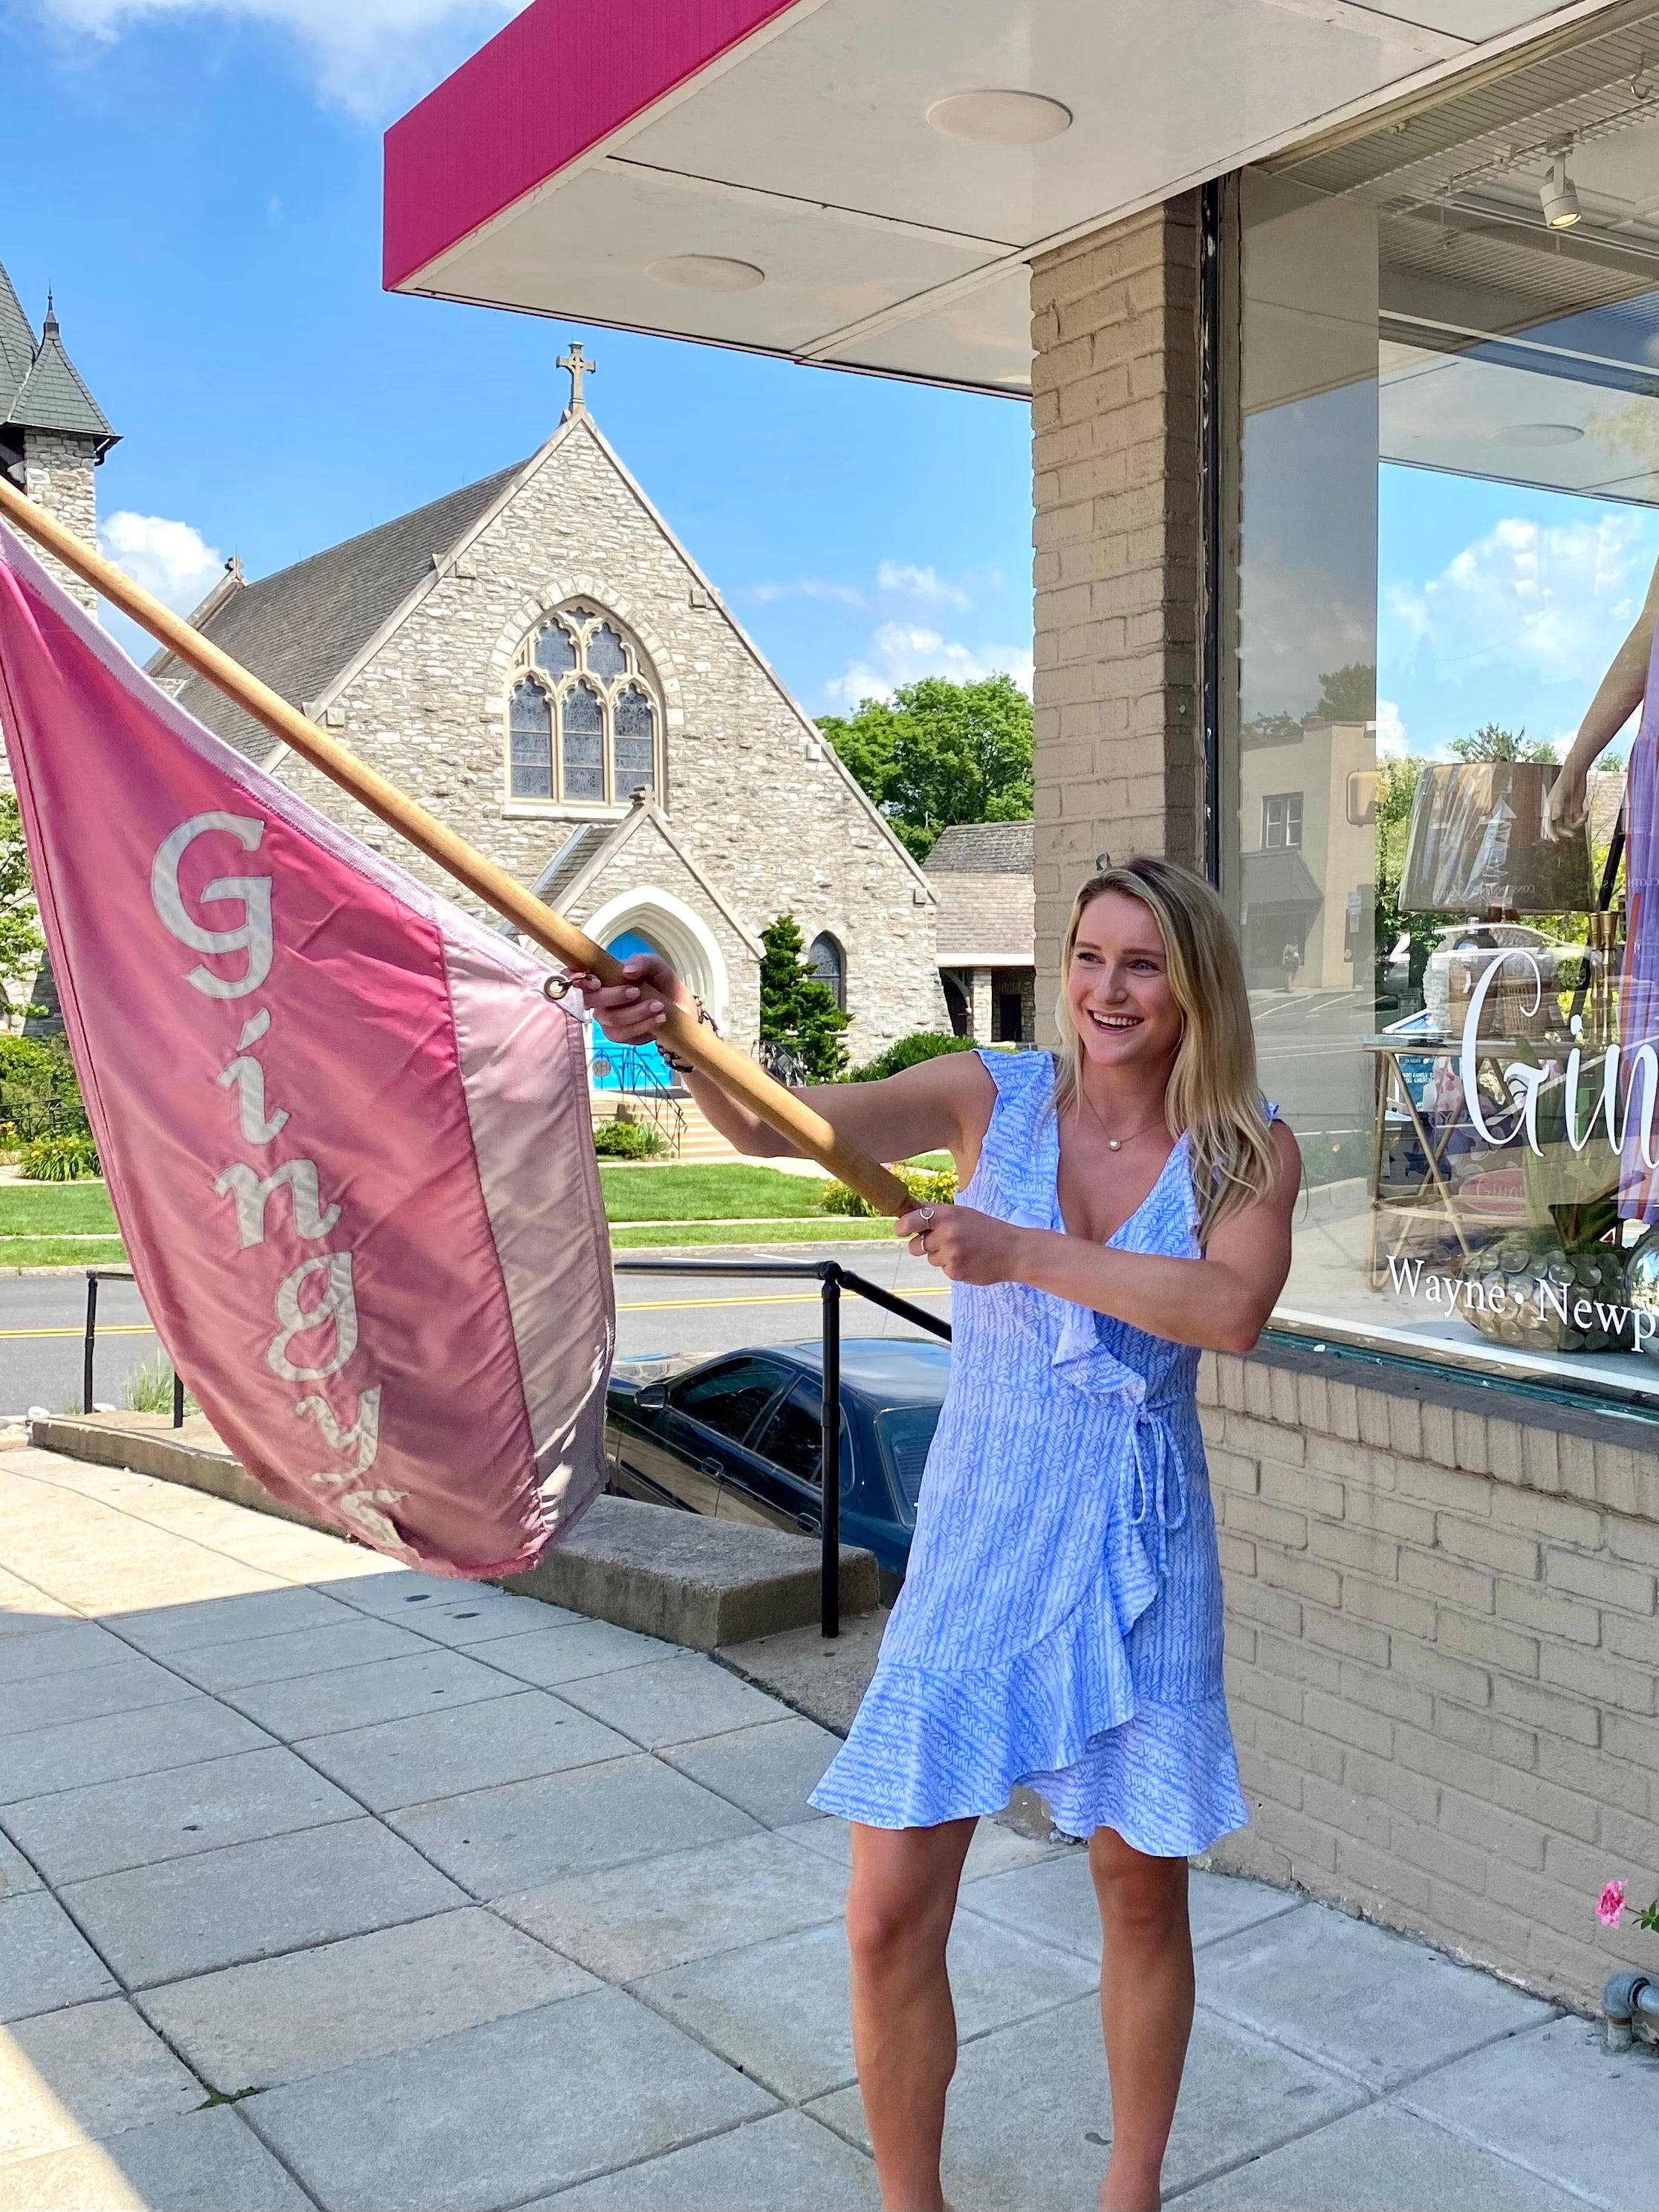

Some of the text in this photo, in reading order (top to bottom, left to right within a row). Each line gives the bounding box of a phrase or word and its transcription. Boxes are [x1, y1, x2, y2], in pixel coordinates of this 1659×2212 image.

[1461, 950, 1659, 1169] Gin
[1386, 1254, 1657, 1354] Wayne Newp
